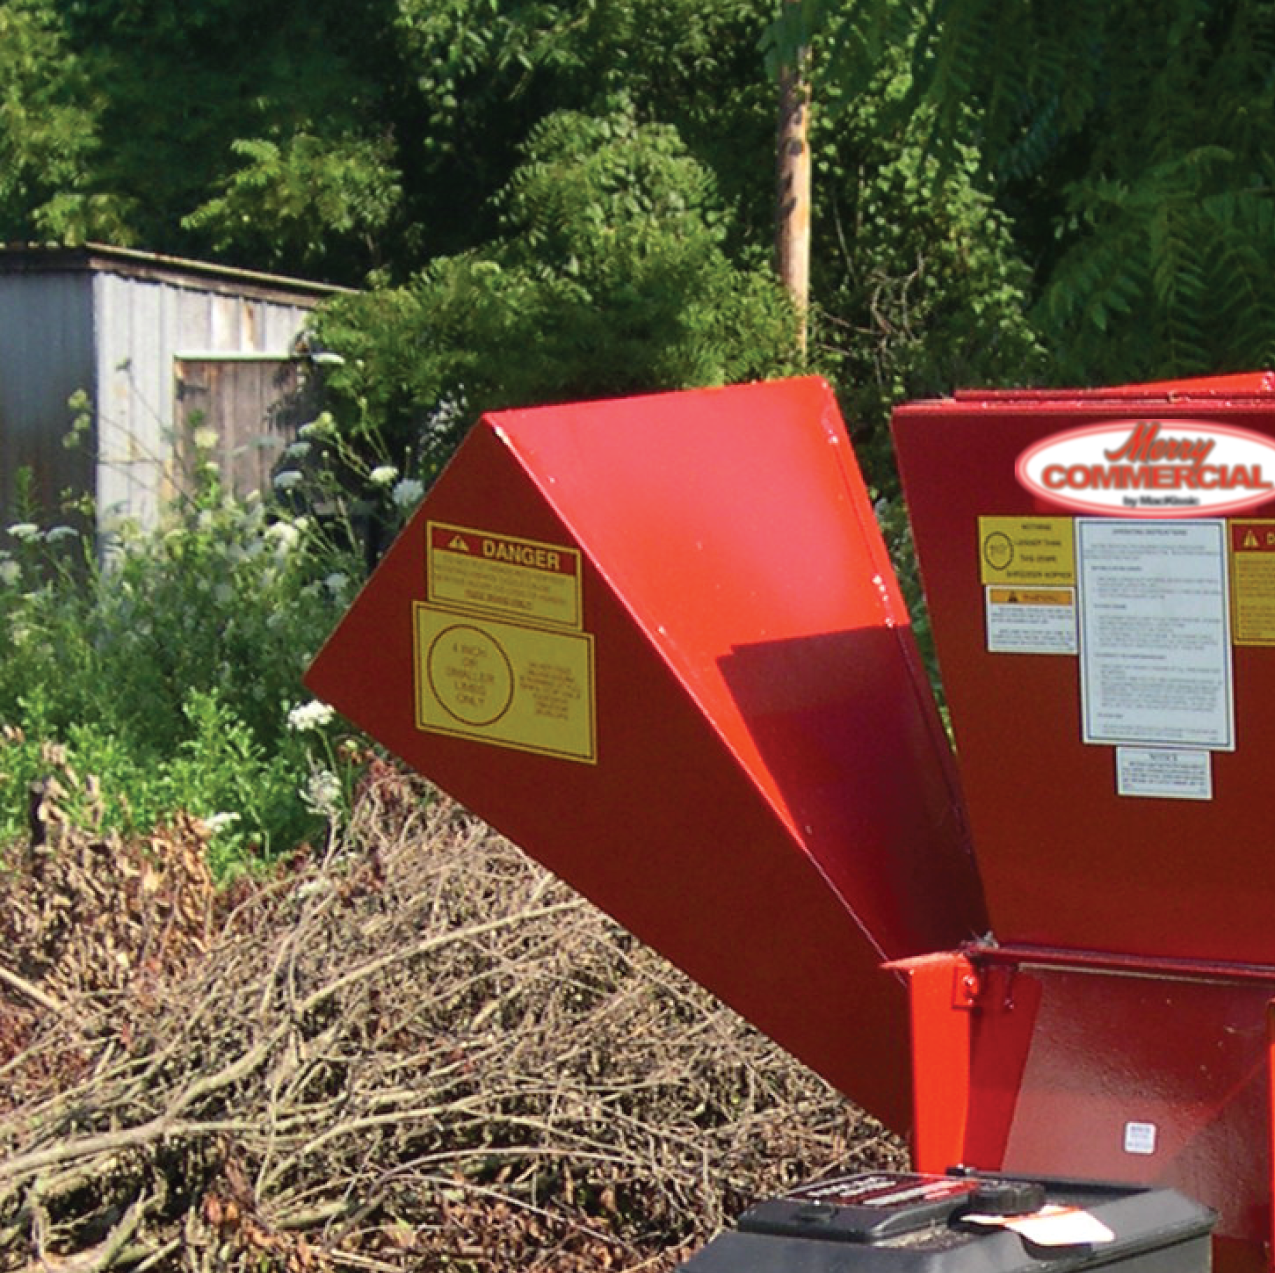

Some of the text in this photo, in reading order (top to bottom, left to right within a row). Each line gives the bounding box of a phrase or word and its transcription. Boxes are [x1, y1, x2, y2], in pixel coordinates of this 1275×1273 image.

[1104, 421, 1216, 468] Merry
[1041, 464, 1273, 490] COMMERCIAL
[482, 538, 560, 571] DANGER
